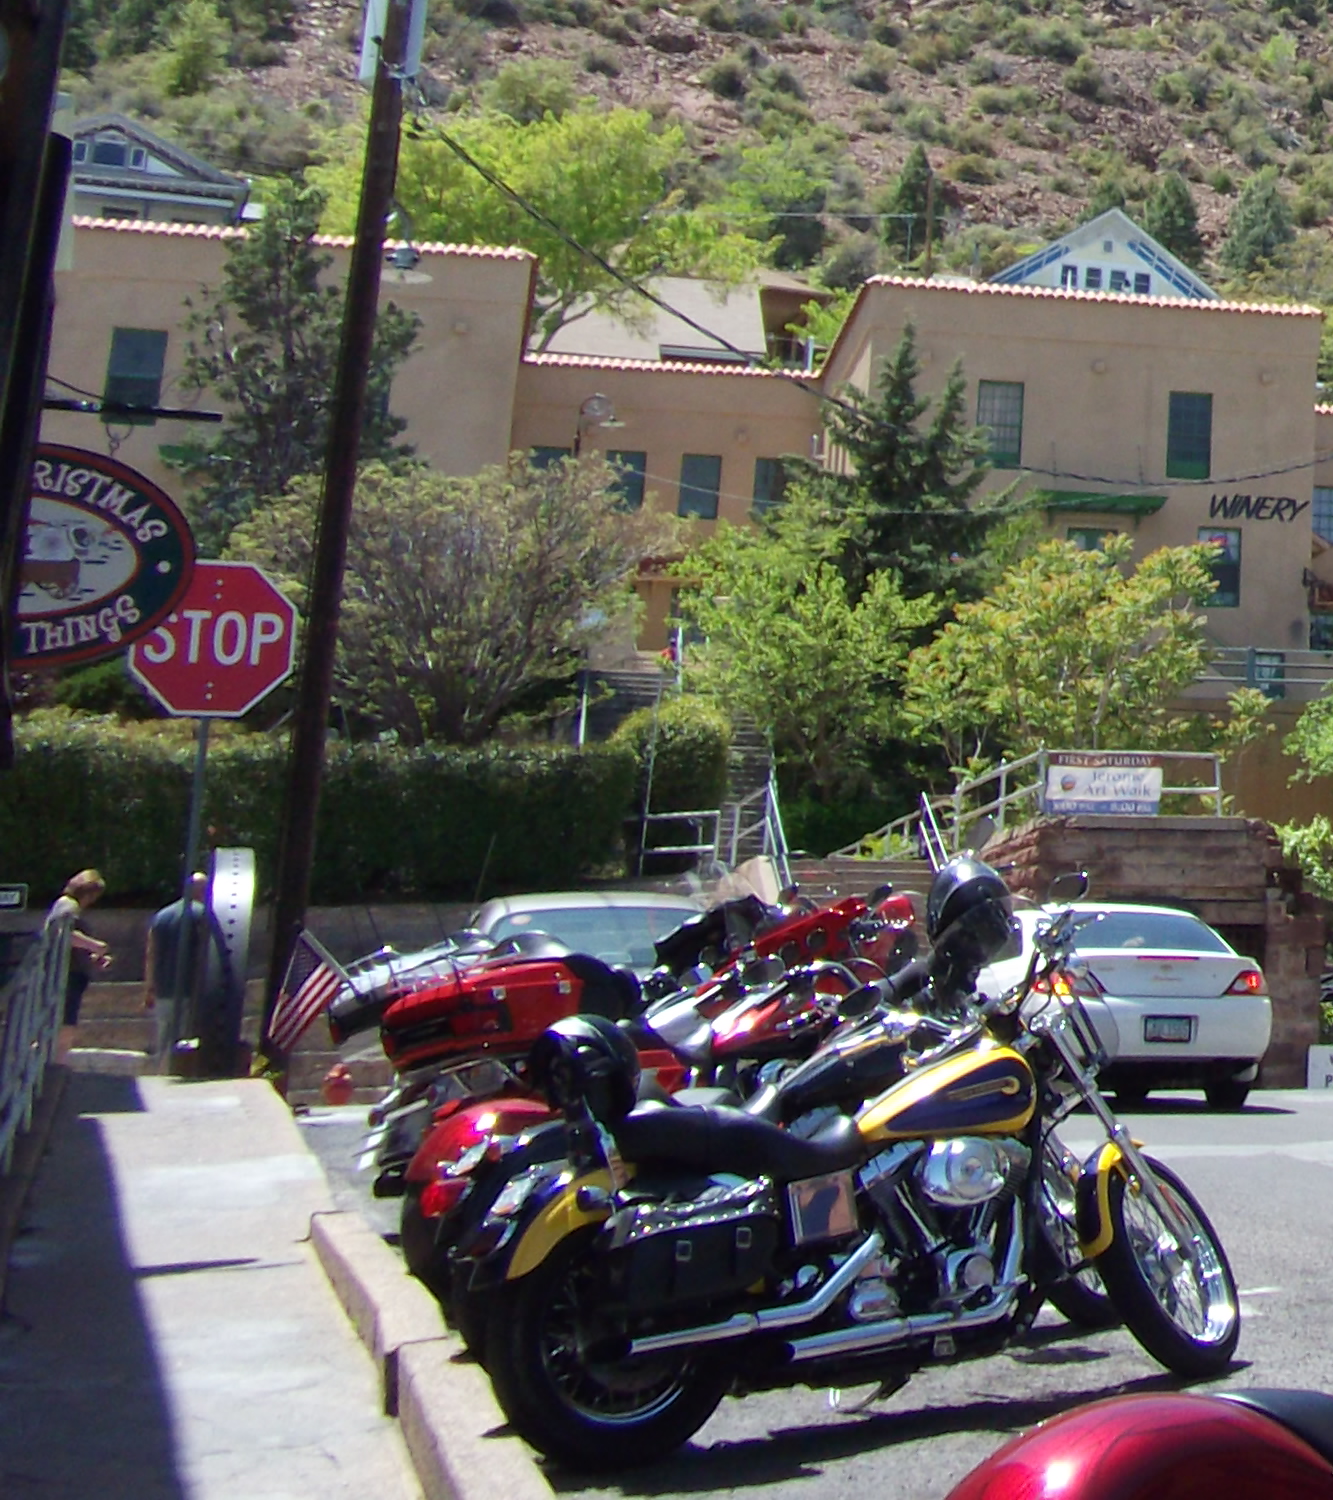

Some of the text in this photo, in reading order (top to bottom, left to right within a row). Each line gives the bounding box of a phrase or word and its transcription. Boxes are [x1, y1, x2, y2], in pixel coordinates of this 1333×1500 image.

[33, 459, 168, 542] RISTMAS
[1210, 494, 1310, 521] WINERY
[20, 595, 140, 653] THINGS
[144, 610, 284, 666] STOP
[1059, 755, 1154, 766] FIRST SATURDAY
[1085, 785, 1151, 797] Art Walk
